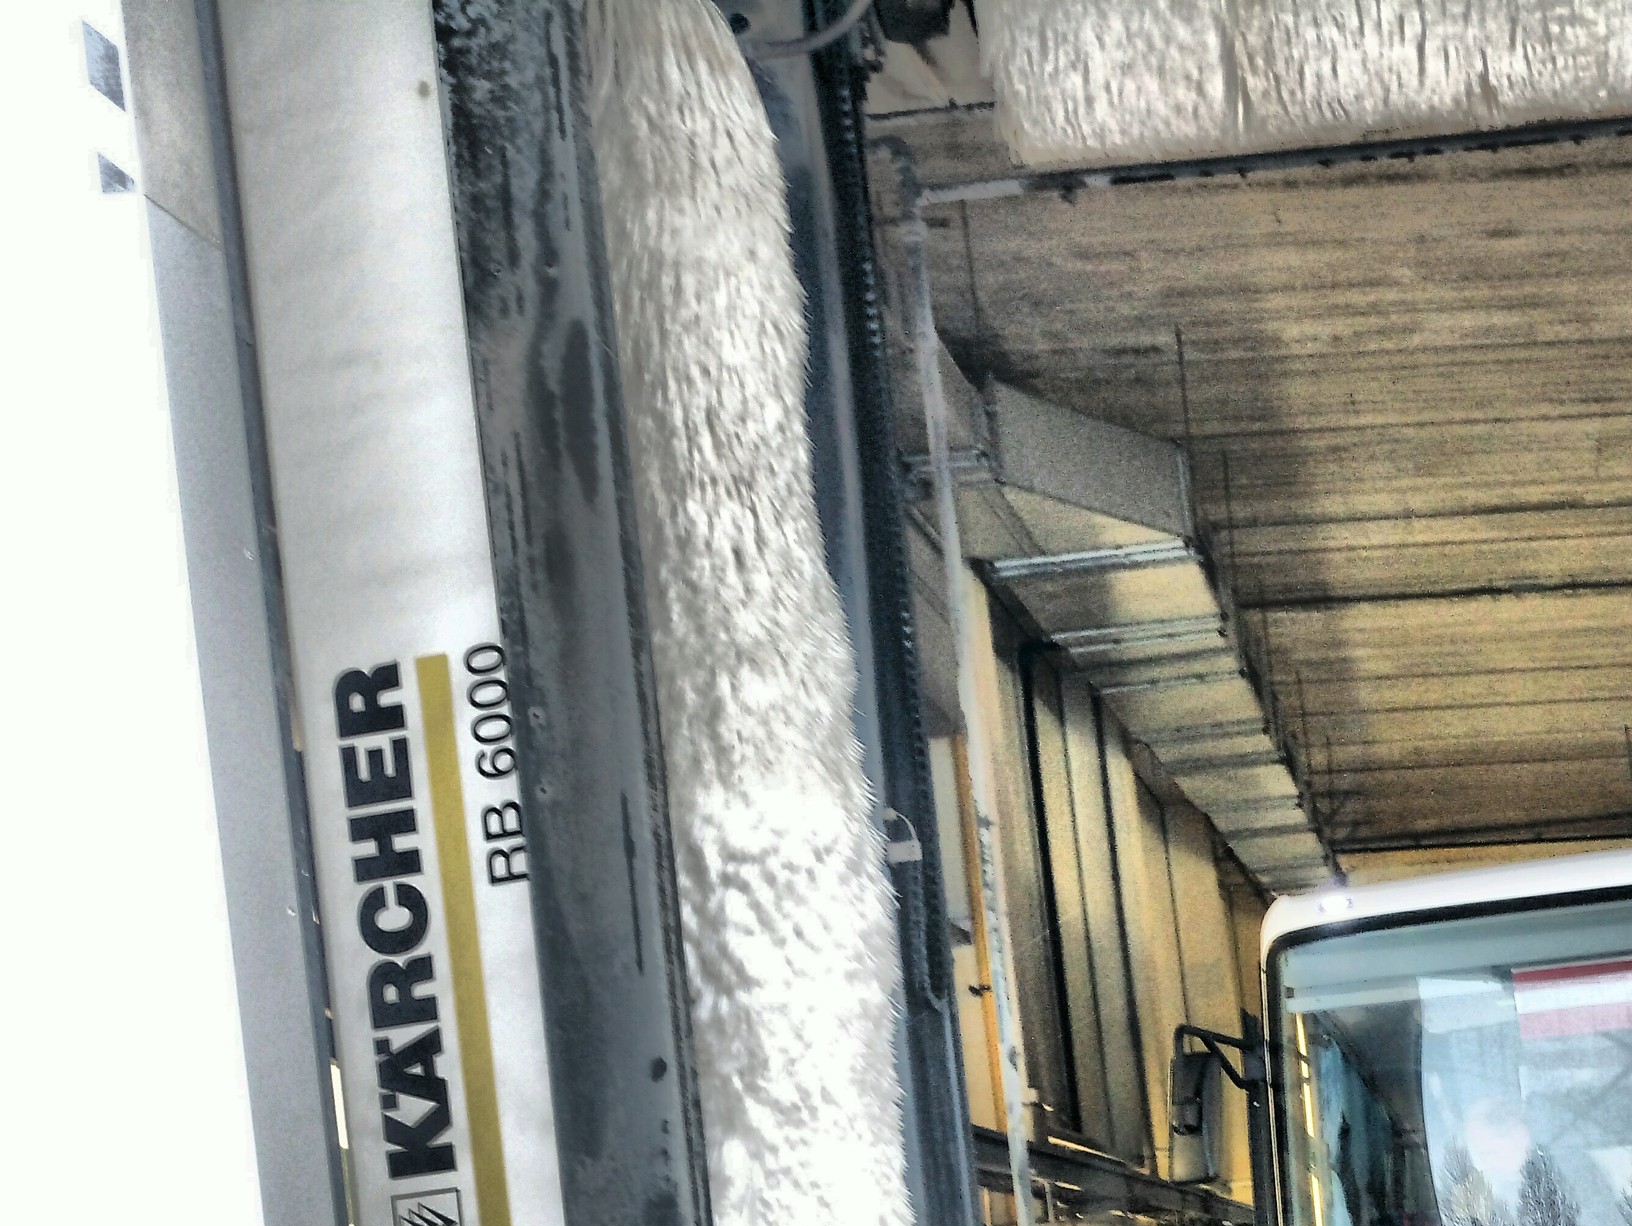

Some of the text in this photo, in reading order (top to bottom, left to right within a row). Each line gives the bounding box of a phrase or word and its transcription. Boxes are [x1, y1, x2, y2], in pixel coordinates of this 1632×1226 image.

[332, 659, 457, 1180] KÄRCHER
[464, 643, 531, 885] RB 6000
